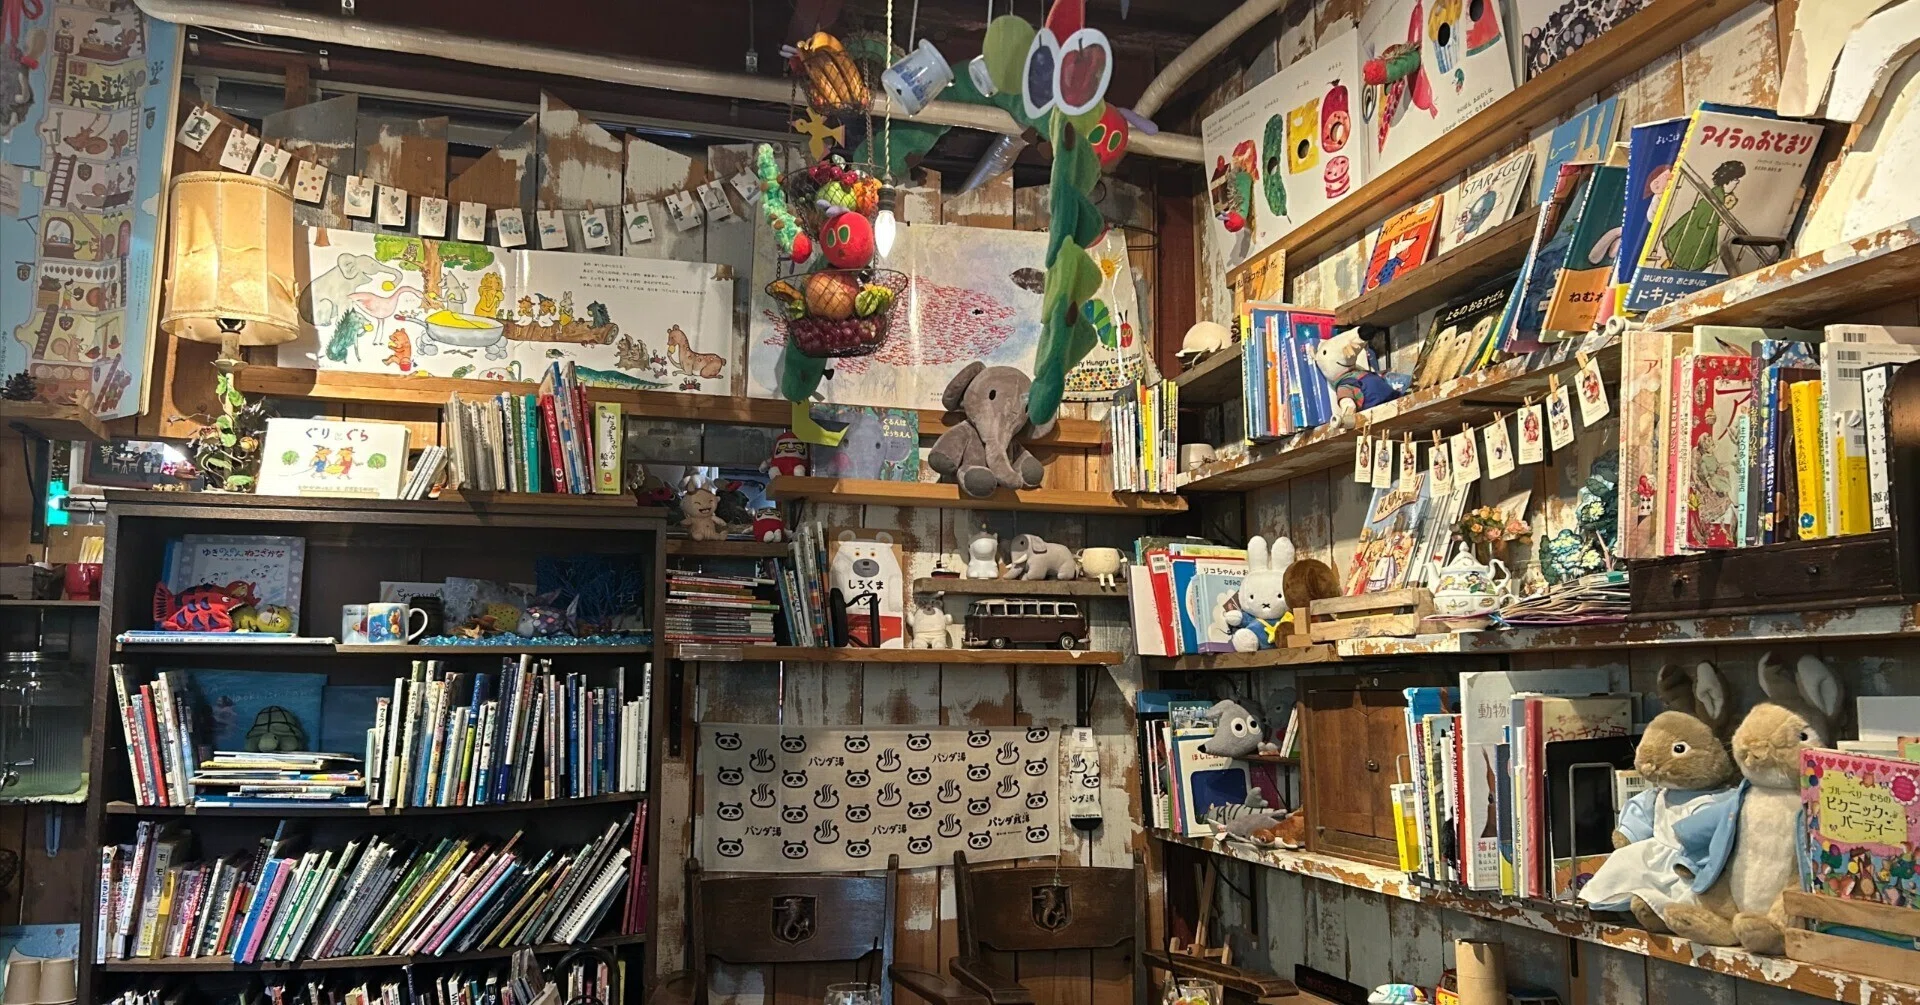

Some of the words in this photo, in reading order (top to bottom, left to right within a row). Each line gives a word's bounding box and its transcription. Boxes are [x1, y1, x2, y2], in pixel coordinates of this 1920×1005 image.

[1700, 125, 1814, 155] アイラのおとまり
[1462, 172, 1493, 199] STAR
[1493, 155, 1524, 182] EGG
[1642, 274, 1674, 284] はじめての
[1676, 276, 1708, 287] おとまりは、
[1086, 358, 1109, 367] Hungry
[1110, 352, 1141, 364] Caerpillar
[546, 403, 558, 444] いやいやえん
[605, 414, 618, 461] だるまちゃんの
[600, 452, 609, 468] 絵本
[244, 549, 286, 559] ねこざかな
[848, 579, 884, 590] しろくま
[808, 756, 845, 767] パンダ湯
[931, 751, 967, 763] パンダ湯
[1070, 794, 1095, 803] ンダ湯
[1827, 785, 1892, 804] ブルーベリーむらの
[744, 826, 782, 837] パンダ湯
[872, 824, 908, 836] パンダ湯
[1842, 815, 1896, 836] パーティー
